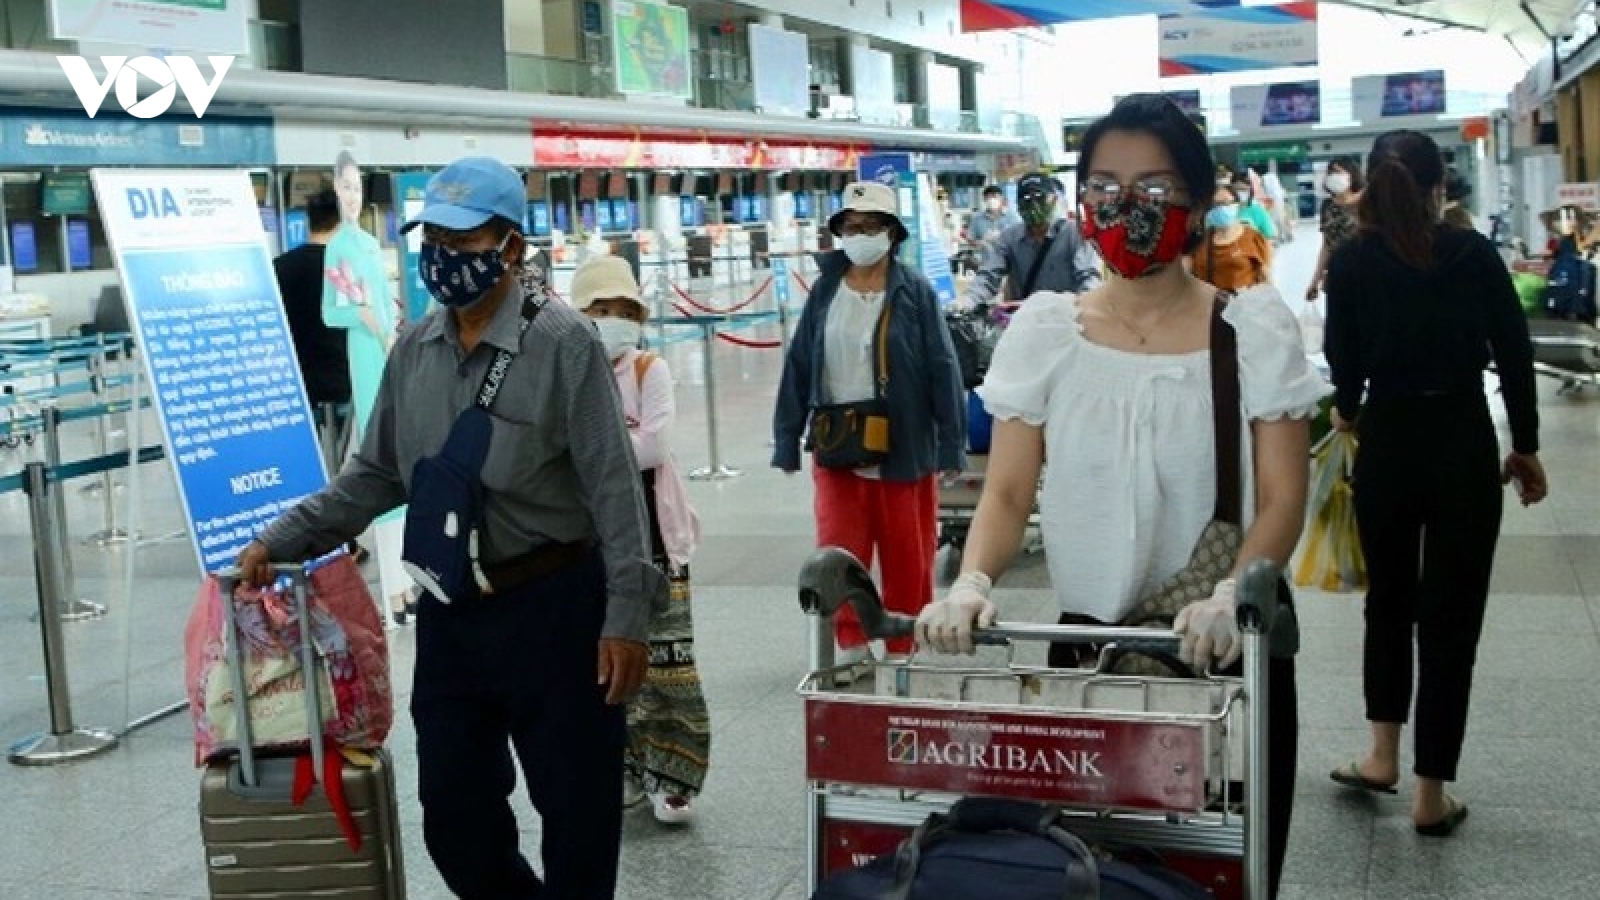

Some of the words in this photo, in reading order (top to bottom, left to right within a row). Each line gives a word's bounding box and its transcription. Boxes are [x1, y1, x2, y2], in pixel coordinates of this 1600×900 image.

[125, 187, 182, 220] DIA
[230, 467, 283, 495] NOTICE
[921, 740, 1104, 778] AGRIBANK
